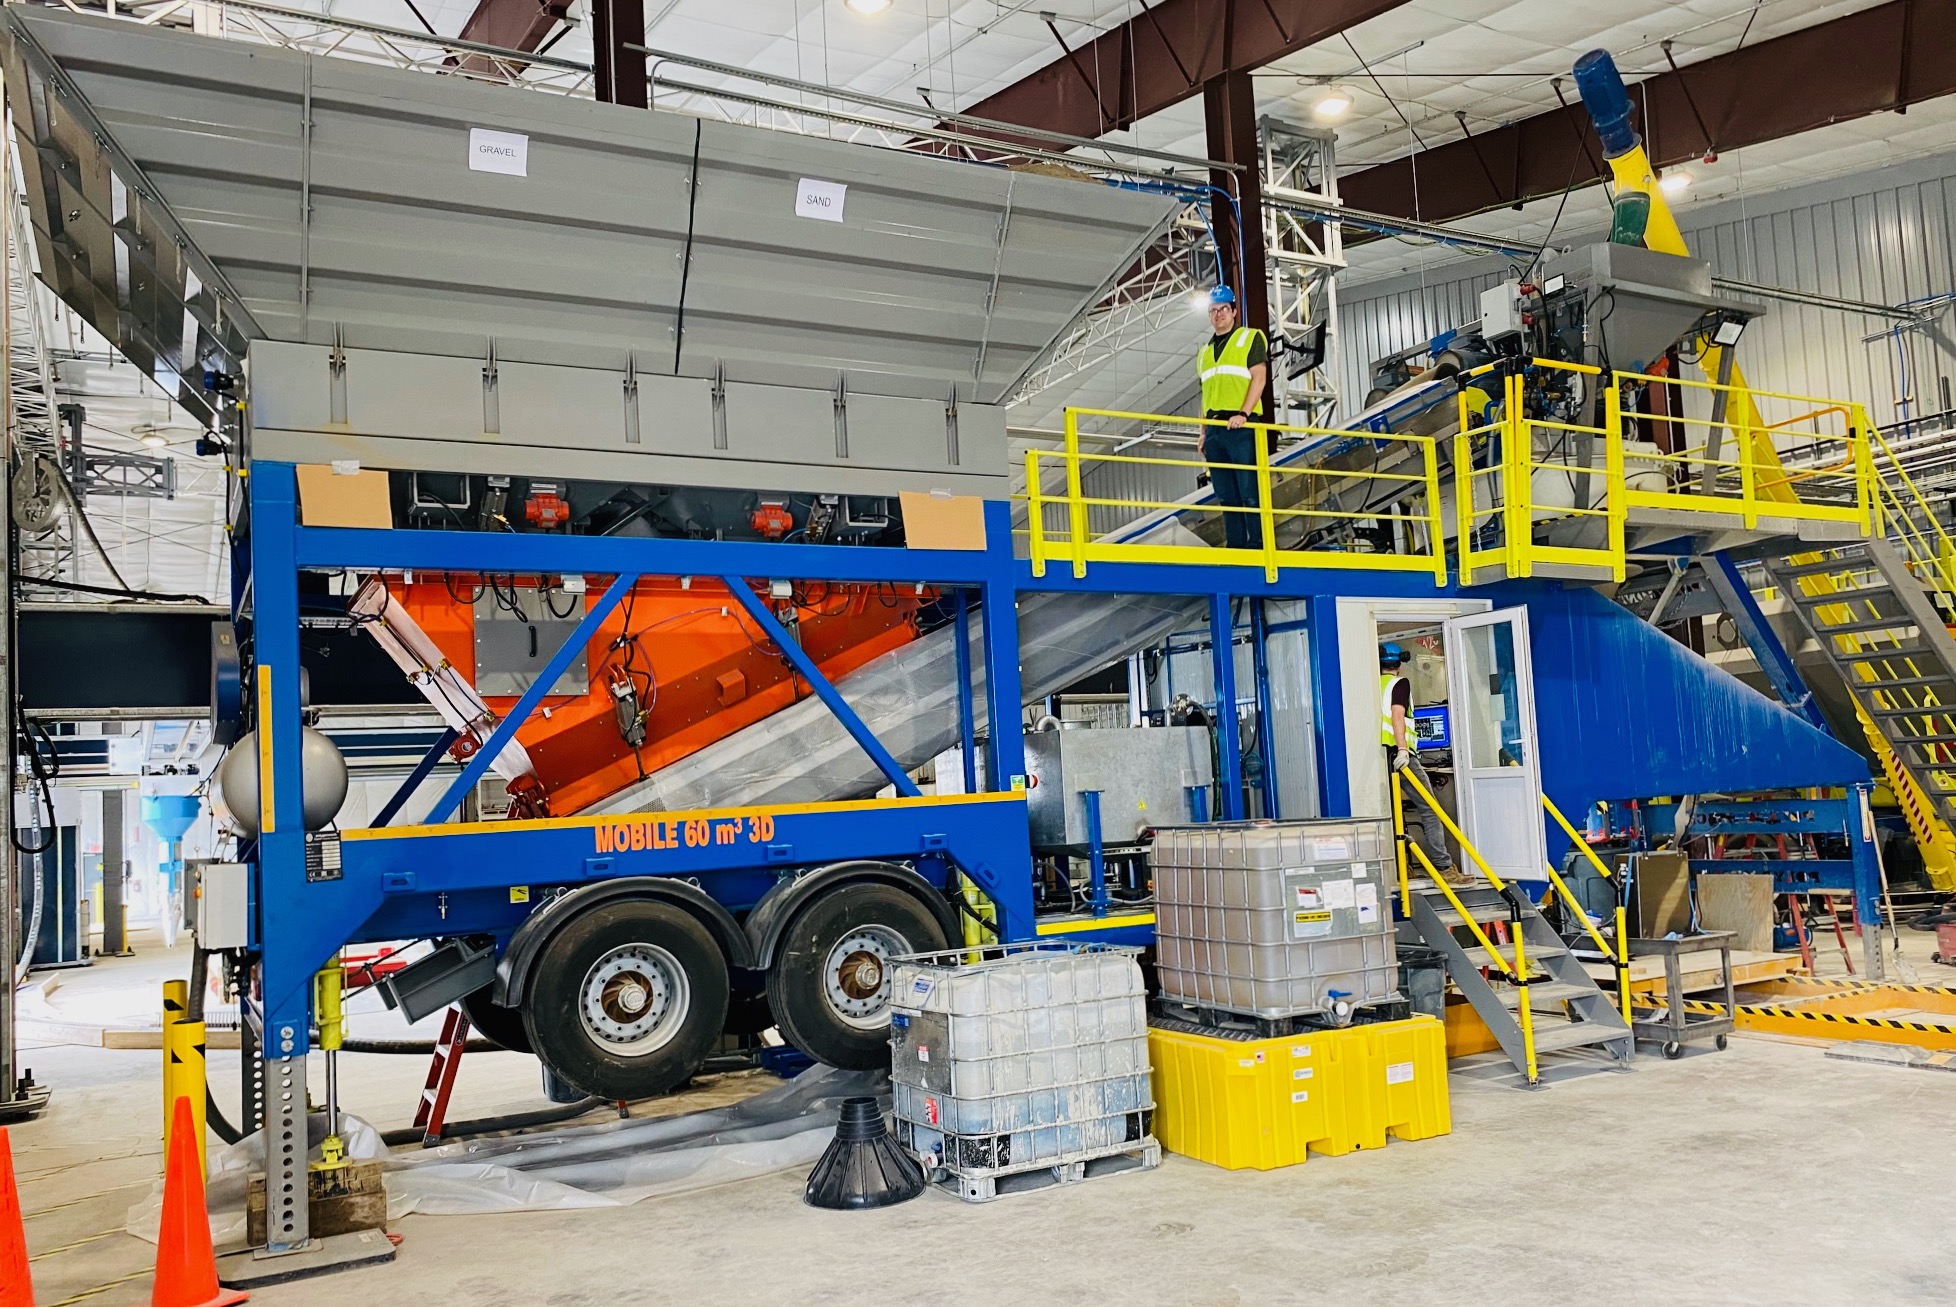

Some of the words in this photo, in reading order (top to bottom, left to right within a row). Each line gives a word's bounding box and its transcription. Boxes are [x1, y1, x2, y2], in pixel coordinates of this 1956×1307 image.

[479, 145, 517, 158] GRAVEL
[806, 194, 832, 208] SAND
[595, 821, 679, 853] MOBILE
[684, 819, 710, 847] 60
[749, 815, 775, 843] 3D
